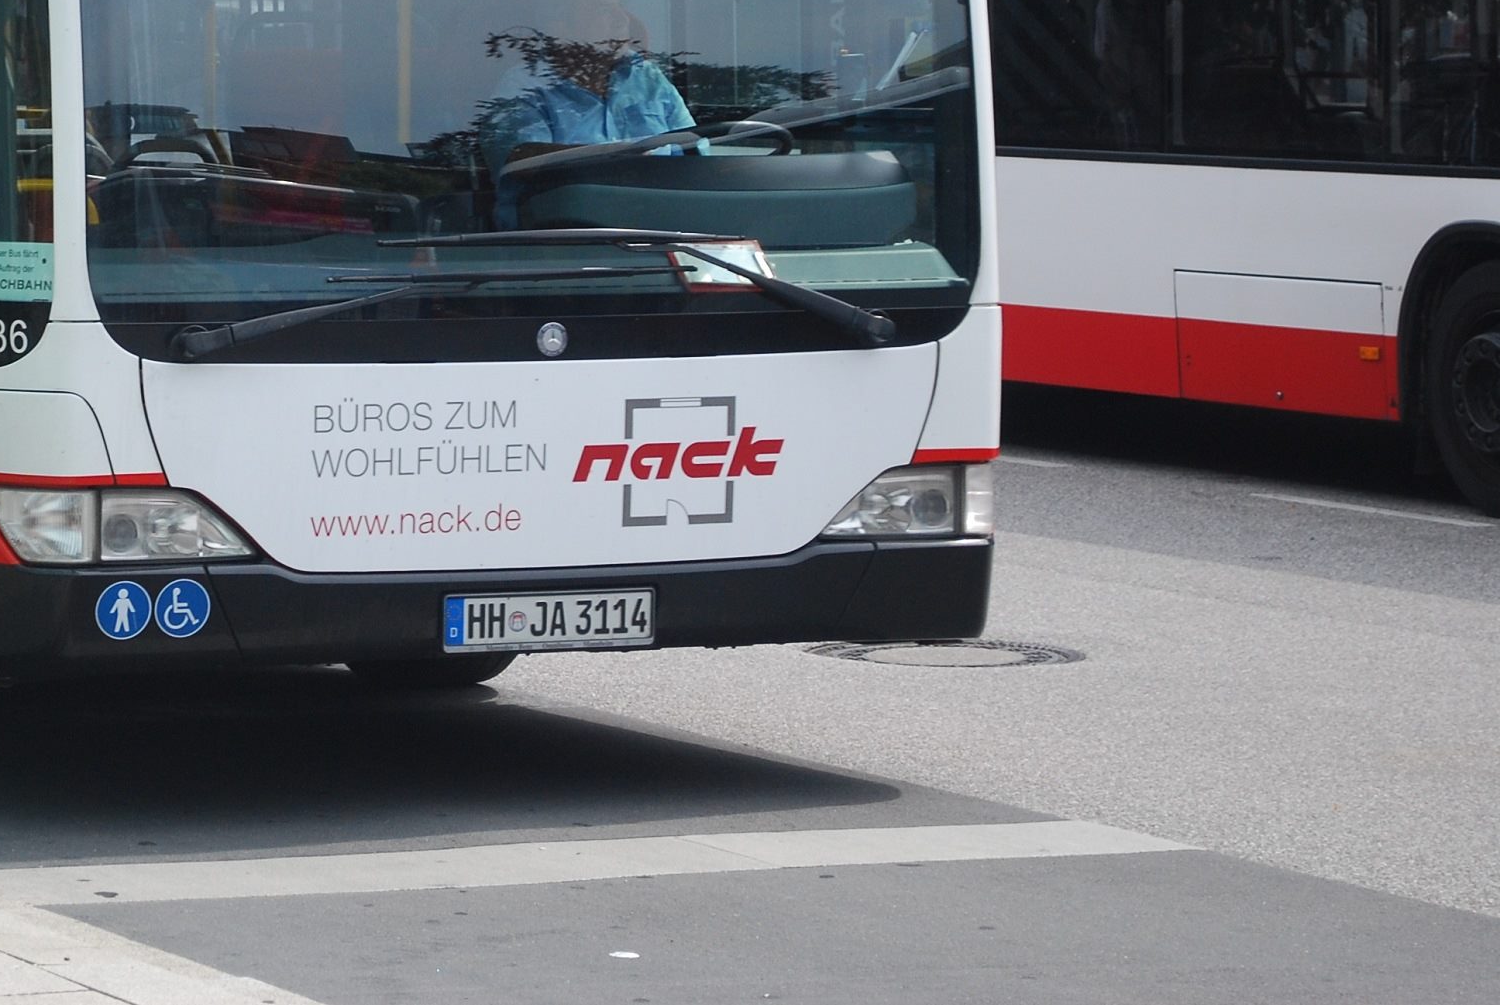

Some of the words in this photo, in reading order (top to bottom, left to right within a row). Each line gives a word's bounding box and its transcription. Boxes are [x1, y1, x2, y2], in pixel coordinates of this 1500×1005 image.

[9, 249, 22, 258] Bus
[23, 265, 35, 273] der
[314, 398, 434, 434] BÜROS
[445, 400, 518, 431] ZUM
[311, 440, 548, 479] WOHLFÜHLEN
[572, 426, 785, 483] nack
[310, 504, 522, 537] www.nack.de
[449, 627, 458, 638] D
[467, 602, 506, 639] HH
[530, 600, 567, 637] JA
[575, 597, 648, 635] 3114
